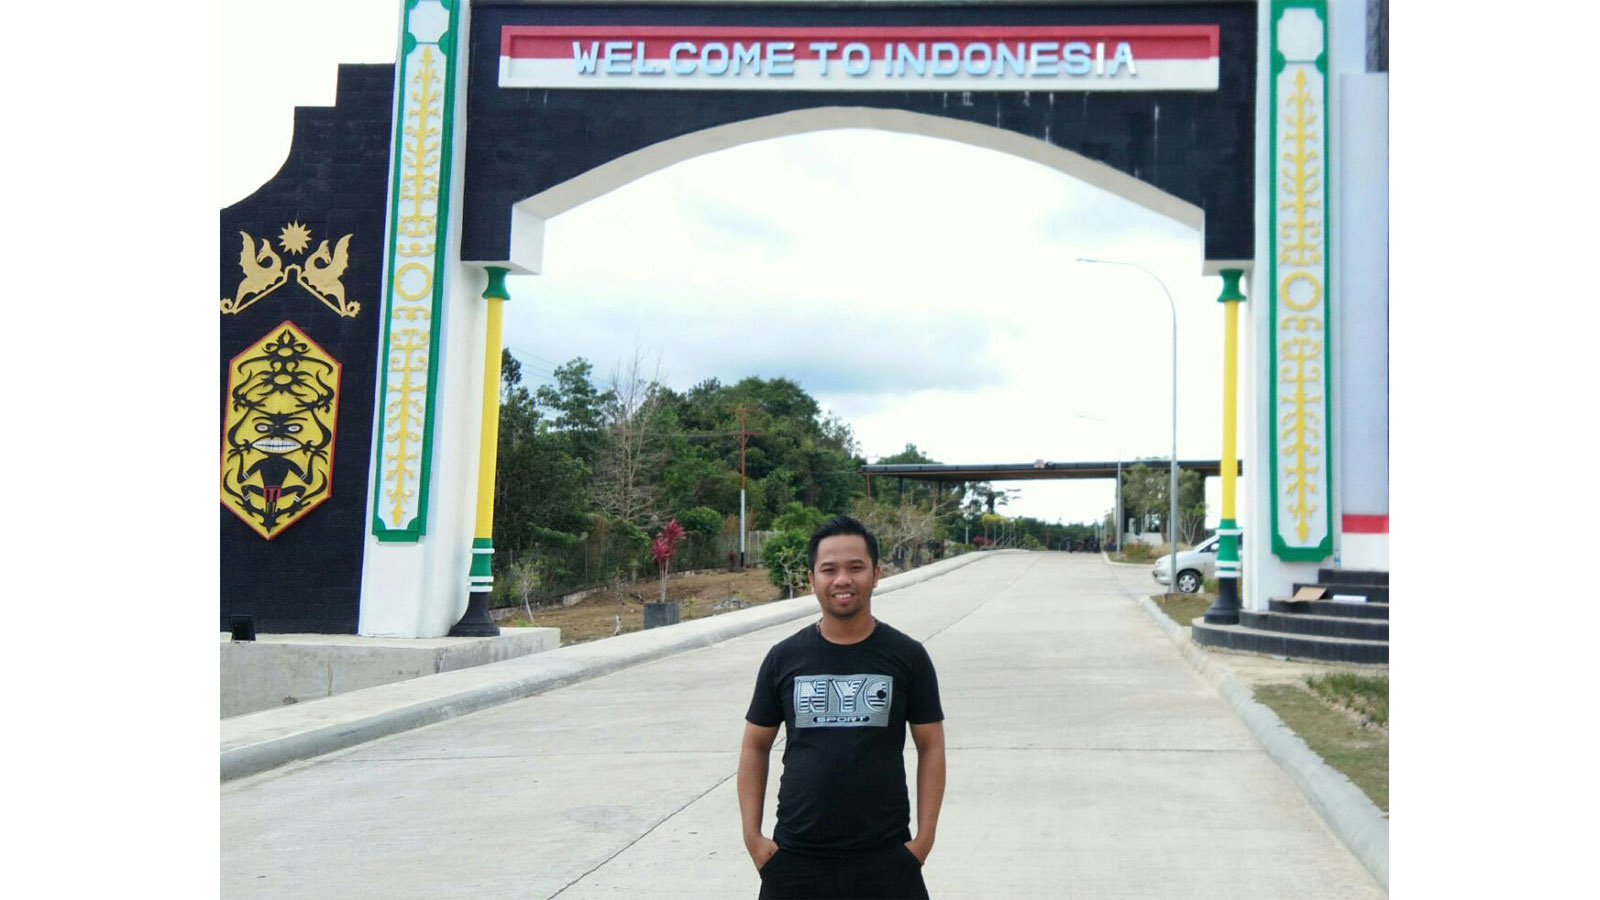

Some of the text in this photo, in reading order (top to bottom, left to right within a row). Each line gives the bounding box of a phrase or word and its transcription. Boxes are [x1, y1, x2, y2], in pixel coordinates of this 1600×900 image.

[572, 40, 1137, 77] WELCOME TO INDONESIA
[797, 679, 889, 713] NYC
[815, 715, 868, 723] SPORT
